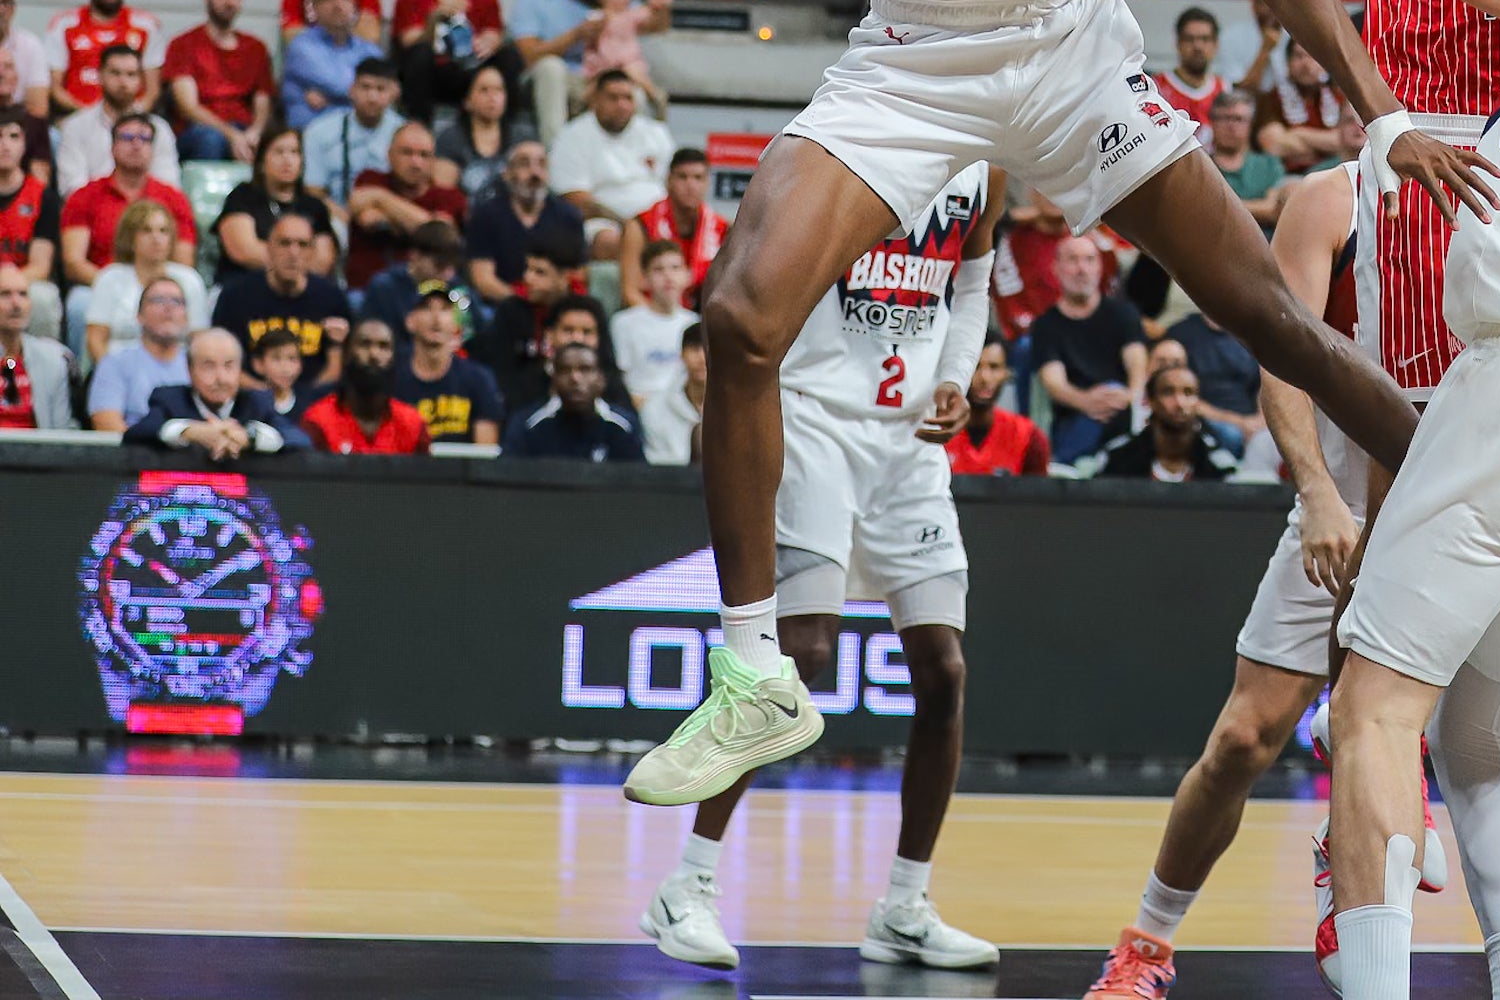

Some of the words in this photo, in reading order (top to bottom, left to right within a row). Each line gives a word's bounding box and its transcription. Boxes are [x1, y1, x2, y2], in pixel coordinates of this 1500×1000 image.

[1099, 132, 1147, 174] HYUNDAI
[875, 355, 906, 409] 2
[561, 624, 917, 717] LOUS
